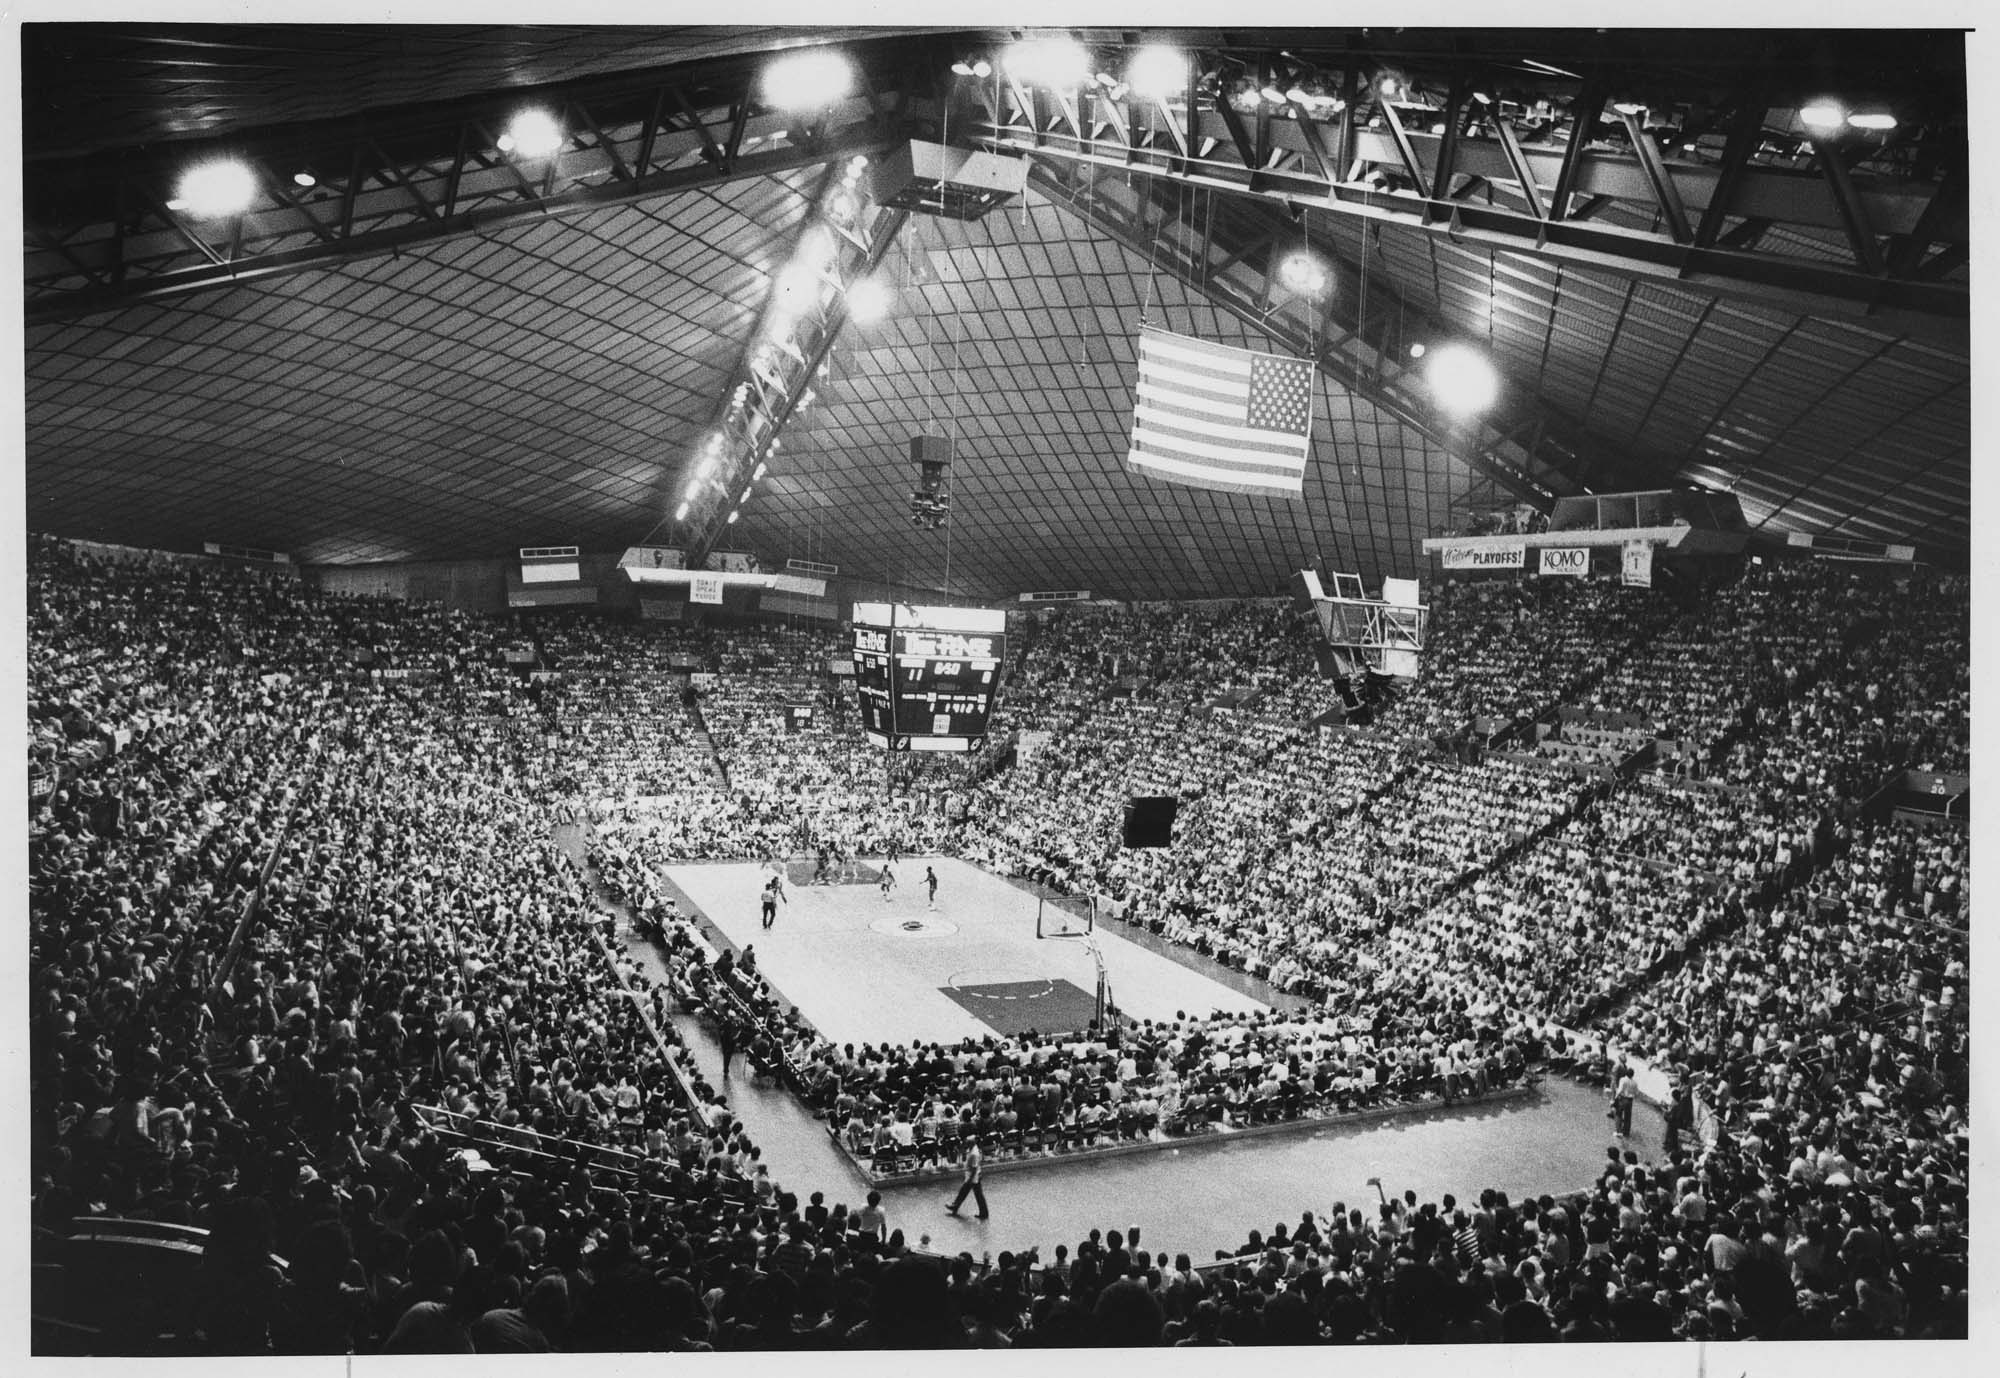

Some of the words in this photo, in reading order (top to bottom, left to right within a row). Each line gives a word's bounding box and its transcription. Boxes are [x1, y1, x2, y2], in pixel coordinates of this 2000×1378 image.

[1473, 550, 1522, 564] PLAYOFFS!
[1544, 550, 1585, 569] KOMO
[1930, 784, 1945, 795] 20
